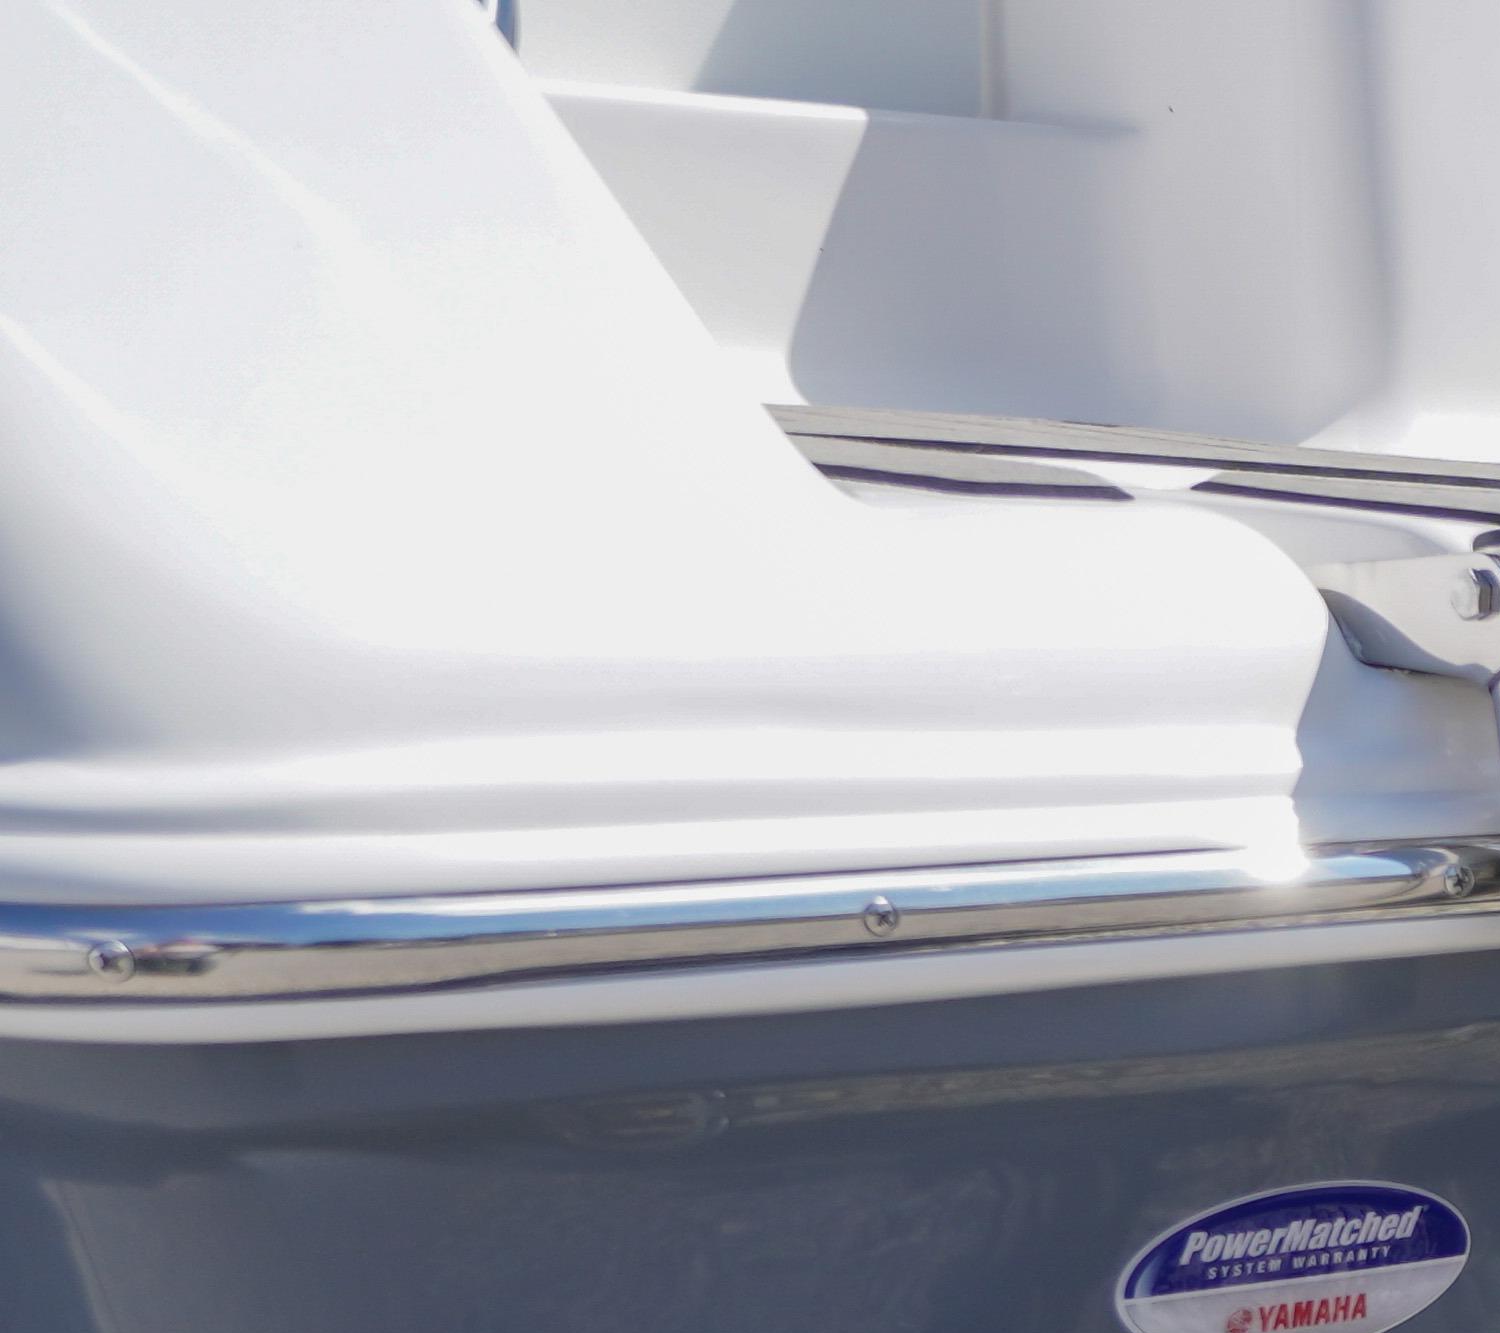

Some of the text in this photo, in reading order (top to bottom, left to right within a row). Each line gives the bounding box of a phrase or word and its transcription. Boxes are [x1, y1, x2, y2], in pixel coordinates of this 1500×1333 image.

[1178, 1205, 1423, 1266] PowerMatched
[1206, 1244, 1392, 1280] SYSTEM WARRANTY
[1257, 1292, 1368, 1333] YAMAHA
